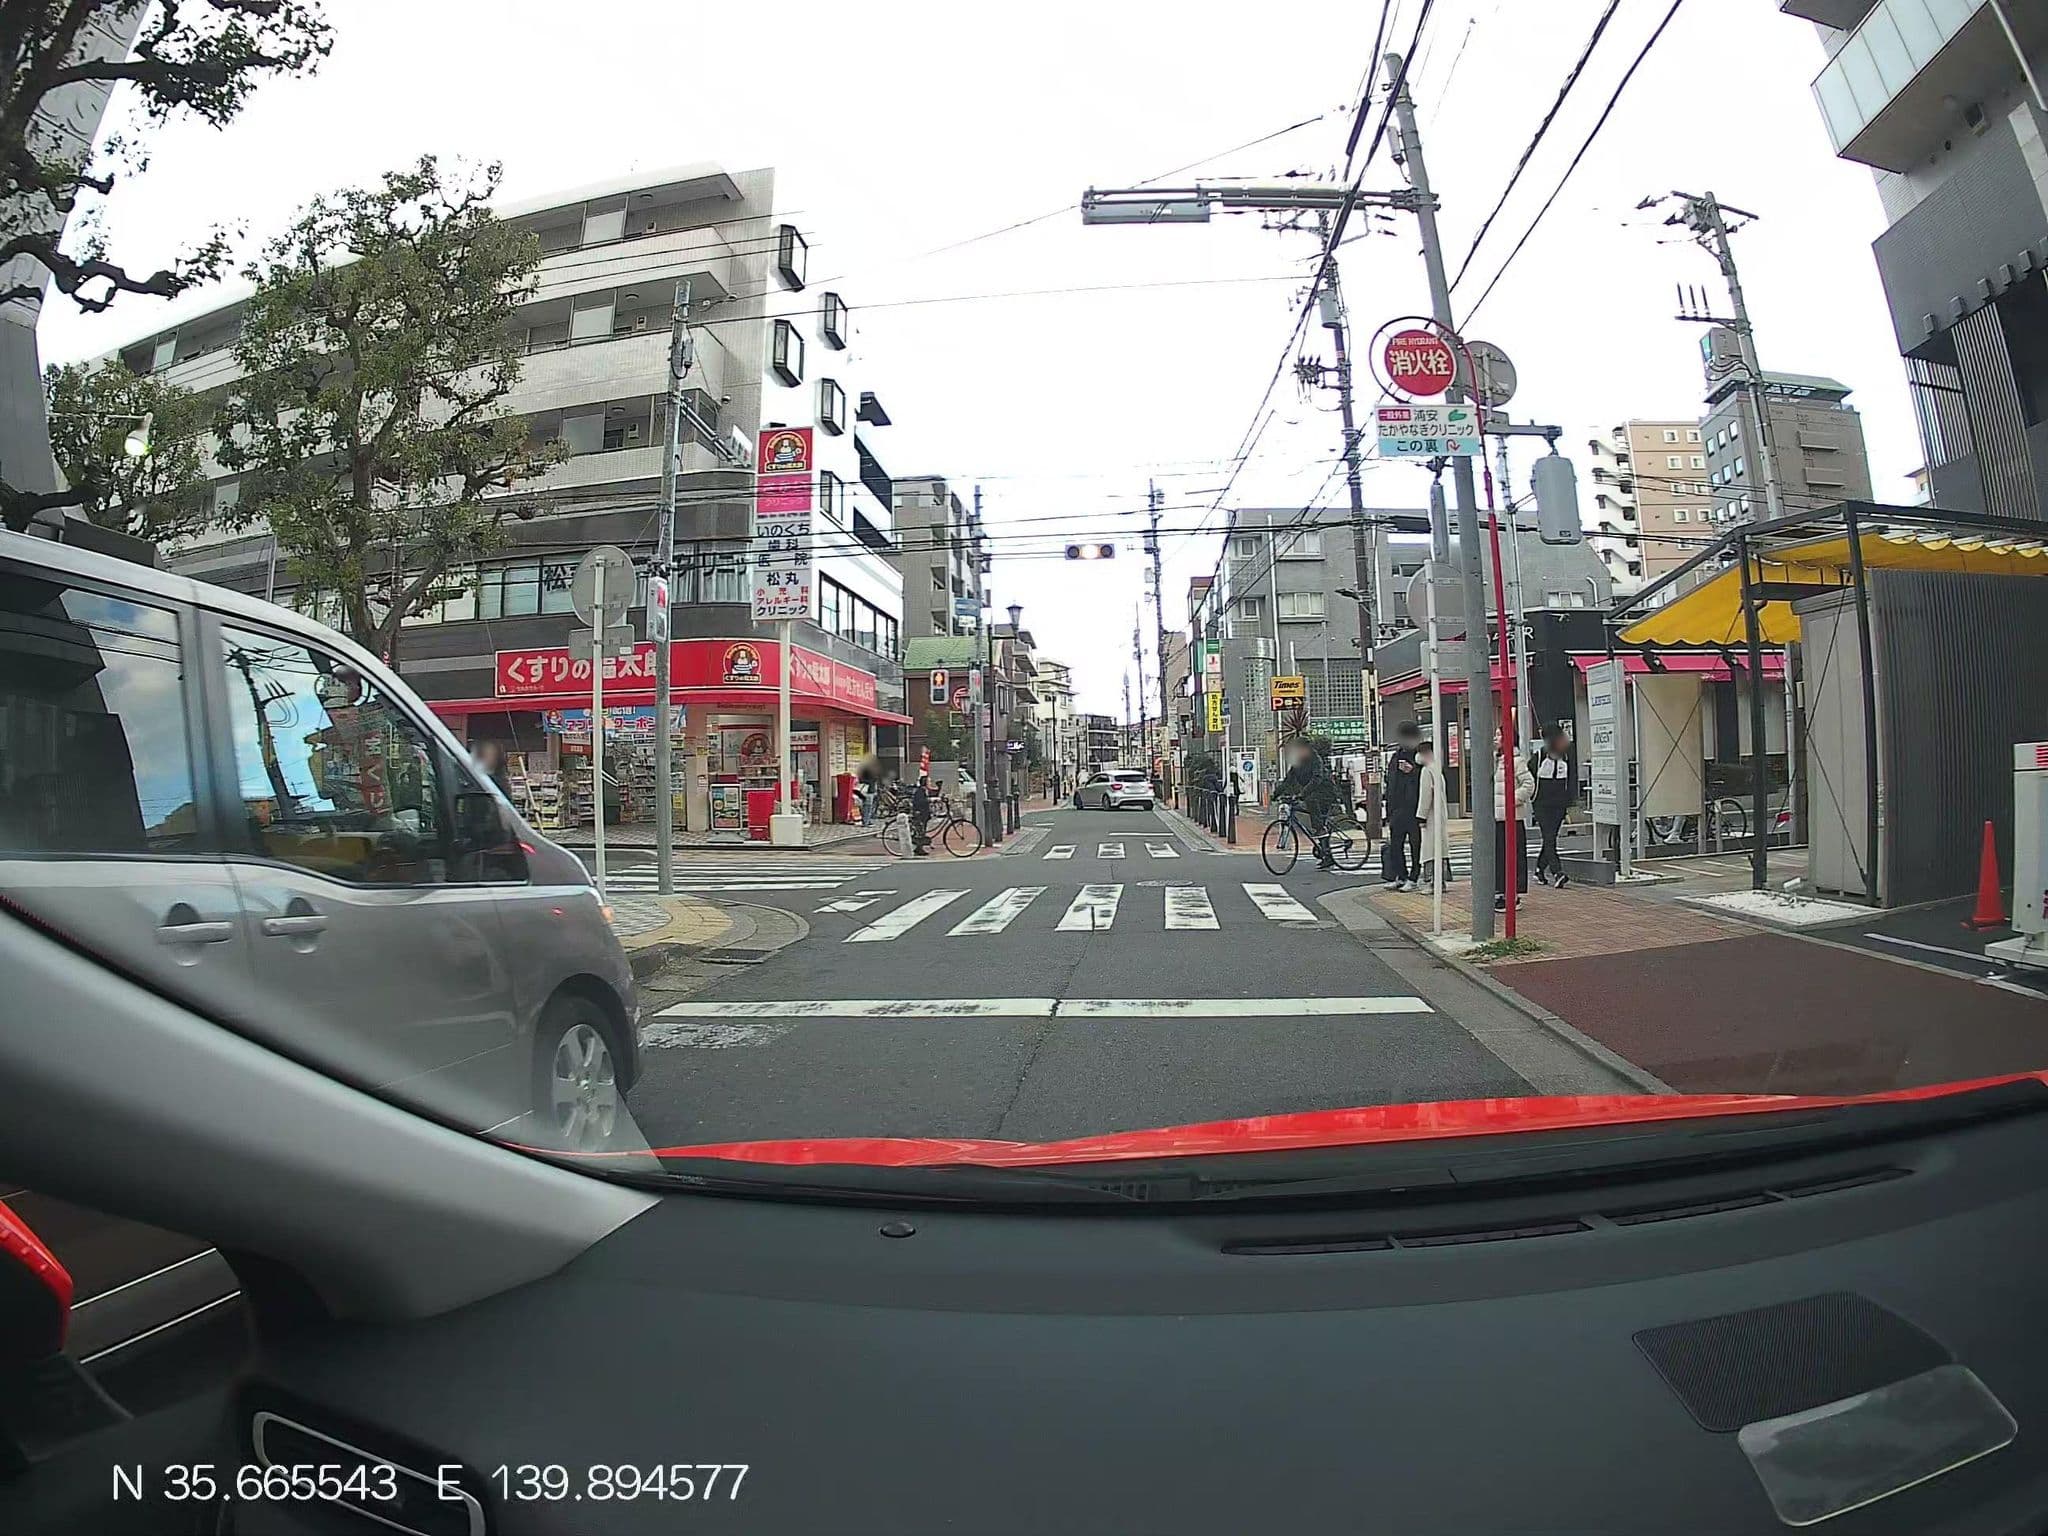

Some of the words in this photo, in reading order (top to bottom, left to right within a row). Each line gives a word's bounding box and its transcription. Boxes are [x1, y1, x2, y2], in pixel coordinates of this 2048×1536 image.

[1389, 349, 1450, 376] 消火栓
[1414, 409, 1438, 421] 浦安
[1378, 424, 1474, 437] たかやなぎクリニック
[1396, 439, 1439, 453] この裏
[757, 523, 810, 536] いのくち
[768, 538, 798, 551] 歯科
[758, 552, 808, 567] 医院
[767, 572, 799, 586] 松丸
[757, 595, 808, 604] アレルギー科
[757, 605, 808, 616] クリニック
[508, 650, 656, 683] くすりの福太郎
[1274, 681, 1300, 689] Times
[1272, 697, 1284, 710] P
